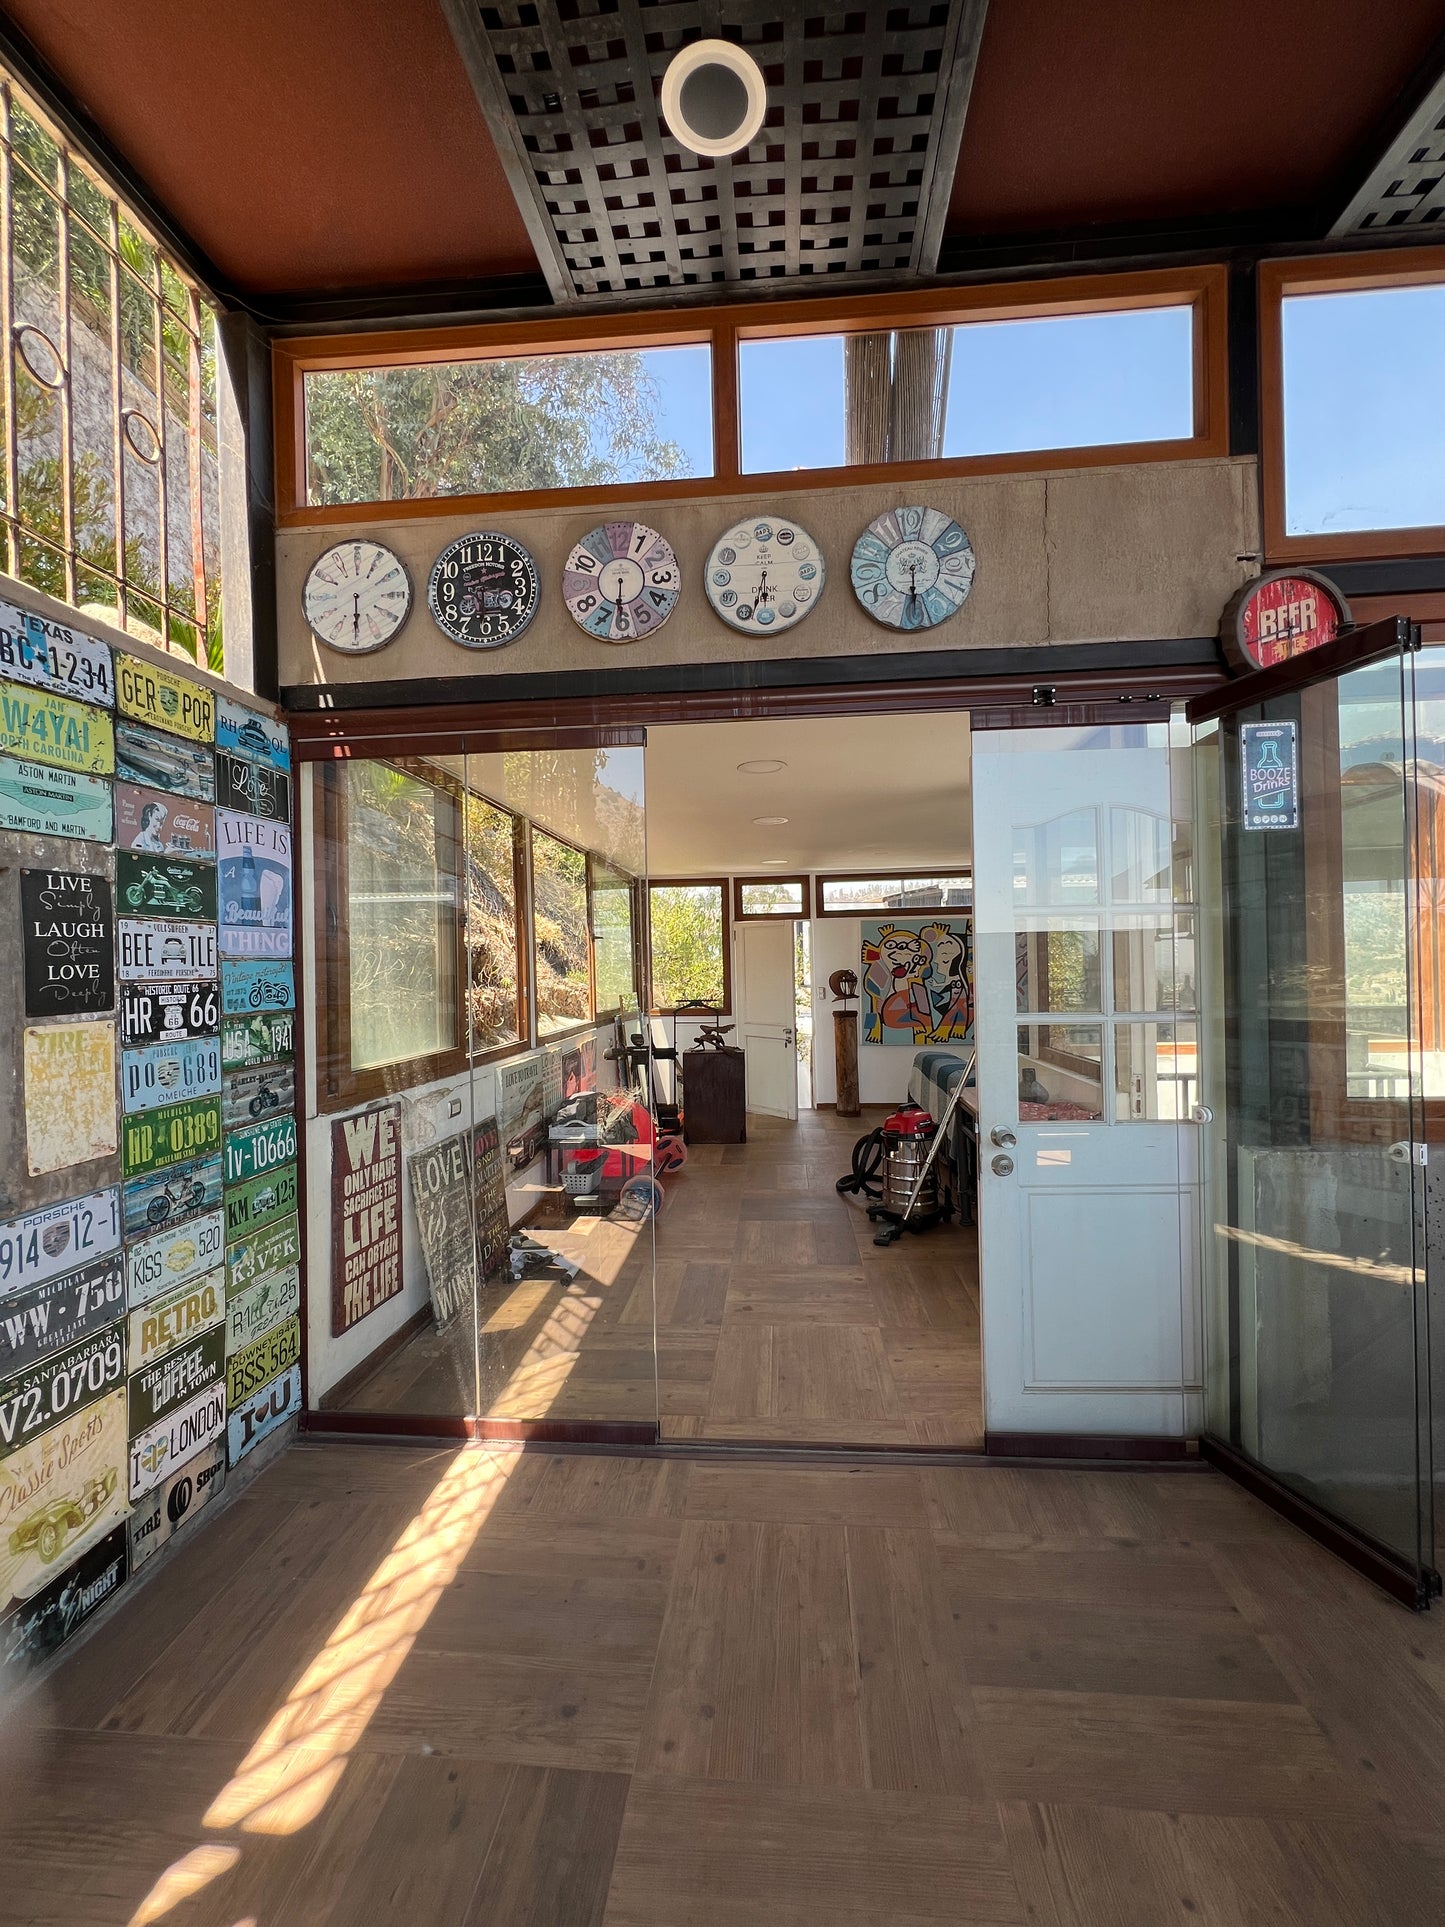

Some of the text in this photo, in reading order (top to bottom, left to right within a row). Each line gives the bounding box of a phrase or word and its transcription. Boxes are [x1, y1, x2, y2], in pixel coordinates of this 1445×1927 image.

[460, 547, 472, 564] 11
[477, 544, 492, 561] 12
[499, 545, 505, 562] 1
[635, 535, 646, 553] 1
[442, 561, 458, 578] 10
[511, 560, 523, 577] 2
[575, 555, 596, 573] 10
[645, 551, 665, 568] 2
[514, 578, 526, 597] 3
[652, 571, 672, 584] 3
[752, 585, 778, 593] DRINK
[443, 582, 455, 602] 9
[649, 591, 667, 607] 4
[445, 604, 457, 621] 8
[511, 598, 525, 615] 4
[577, 595, 596, 613] 8
[634, 604, 651, 624] 5
[17, 611, 73, 644] TEXAS
[460, 617, 471, 633] 7
[481, 615, 492, 635] 6
[498, 616, 510, 632] 5
[1260, 598, 1316, 643] BEER
[156, 671, 181, 688] PORSCHE
[122, 668, 156, 713] GER
[183, 693, 212, 734] POR
[2, 696, 89, 753] W4YAI
[220, 714, 237, 734] RH
[272, 737, 287, 754] QL
[33, 741, 84, 765] CAROLINA
[18, 764, 76, 787] ASTON MARTIN
[1250, 768, 1291, 781] BOOZE
[1253, 777, 1290, 793] Drinks
[24, 787, 72, 802] ASTON MARTIN
[8, 814, 41, 830] BAMFORD
[45, 820, 58, 832] AND
[62, 822, 86, 836] MARTIN
[222, 821, 288, 856] LIFE IS
[46, 875, 92, 892] LIVE
[225, 866, 236, 878] A
[40, 891, 101, 922] Simply
[224, 900, 288, 923] Beautiful
[34, 921, 105, 938] LAUGH
[224, 930, 289, 952] THING
[47, 940, 100, 962] Often
[122, 932, 214, 967] BEE TLE
[48, 964, 100, 980] LOVE
[225, 971, 254, 986] Vintage
[40, 978, 108, 1007] Deeply
[145, 984, 199, 996] HISTORIC ROUTE 66
[125, 992, 218, 1035] HR 66
[168, 1018, 180, 1026] 66
[225, 1024, 292, 1060] USA 1941
[183, 1051, 218, 1086] 689
[244, 1056, 260, 1066] WORLD
[262, 1054, 272, 1062] WAR
[158, 1086, 197, 1102] OMEICHE
[170, 1110, 218, 1152] 0389
[343, 1107, 396, 1172] WE
[344, 1156, 396, 1196] ONLY HAVE
[416, 1144, 464, 1199] LOVE
[228, 1196, 250, 1229] KM
[275, 1177, 295, 1207] 125
[344, 1177, 396, 1218] SACRIFICE THE
[483, 1188, 497, 1203] THE
[24, 1200, 85, 1230] PORSCHE
[344, 1195, 398, 1257] LIFE
[0, 1200, 116, 1280] 914 12-1
[488, 1222, 502, 1239] THE
[483, 1226, 508, 1260] DAYS
[134, 1250, 162, 1288] KISS
[198, 1225, 220, 1257] 520
[346, 1232, 398, 1282] CAN OBTAIN
[75, 1270, 122, 1318] 750
[344, 1254, 398, 1328] THE LIFE
[232, 1305, 250, 1338] R1
[280, 1276, 296, 1306] 25
[141, 1286, 216, 1356] RETRO
[232, 1320, 296, 1371] DOWNEY-1946
[140, 1368, 162, 1393] THE
[164, 1350, 189, 1376] BEST
[152, 1345, 204, 1414] COFFEE
[177, 1360, 218, 1399] IN TOWN
[232, 1332, 297, 1404] BSS.564
[240, 1377, 292, 1450] I U
[133, 1393, 225, 1489] I LONDON
[0, 1414, 103, 1514] Classic Sports
[132, 1459, 224, 1545] TIRE SHOP
[82, 1564, 118, 1612] NIGHT
